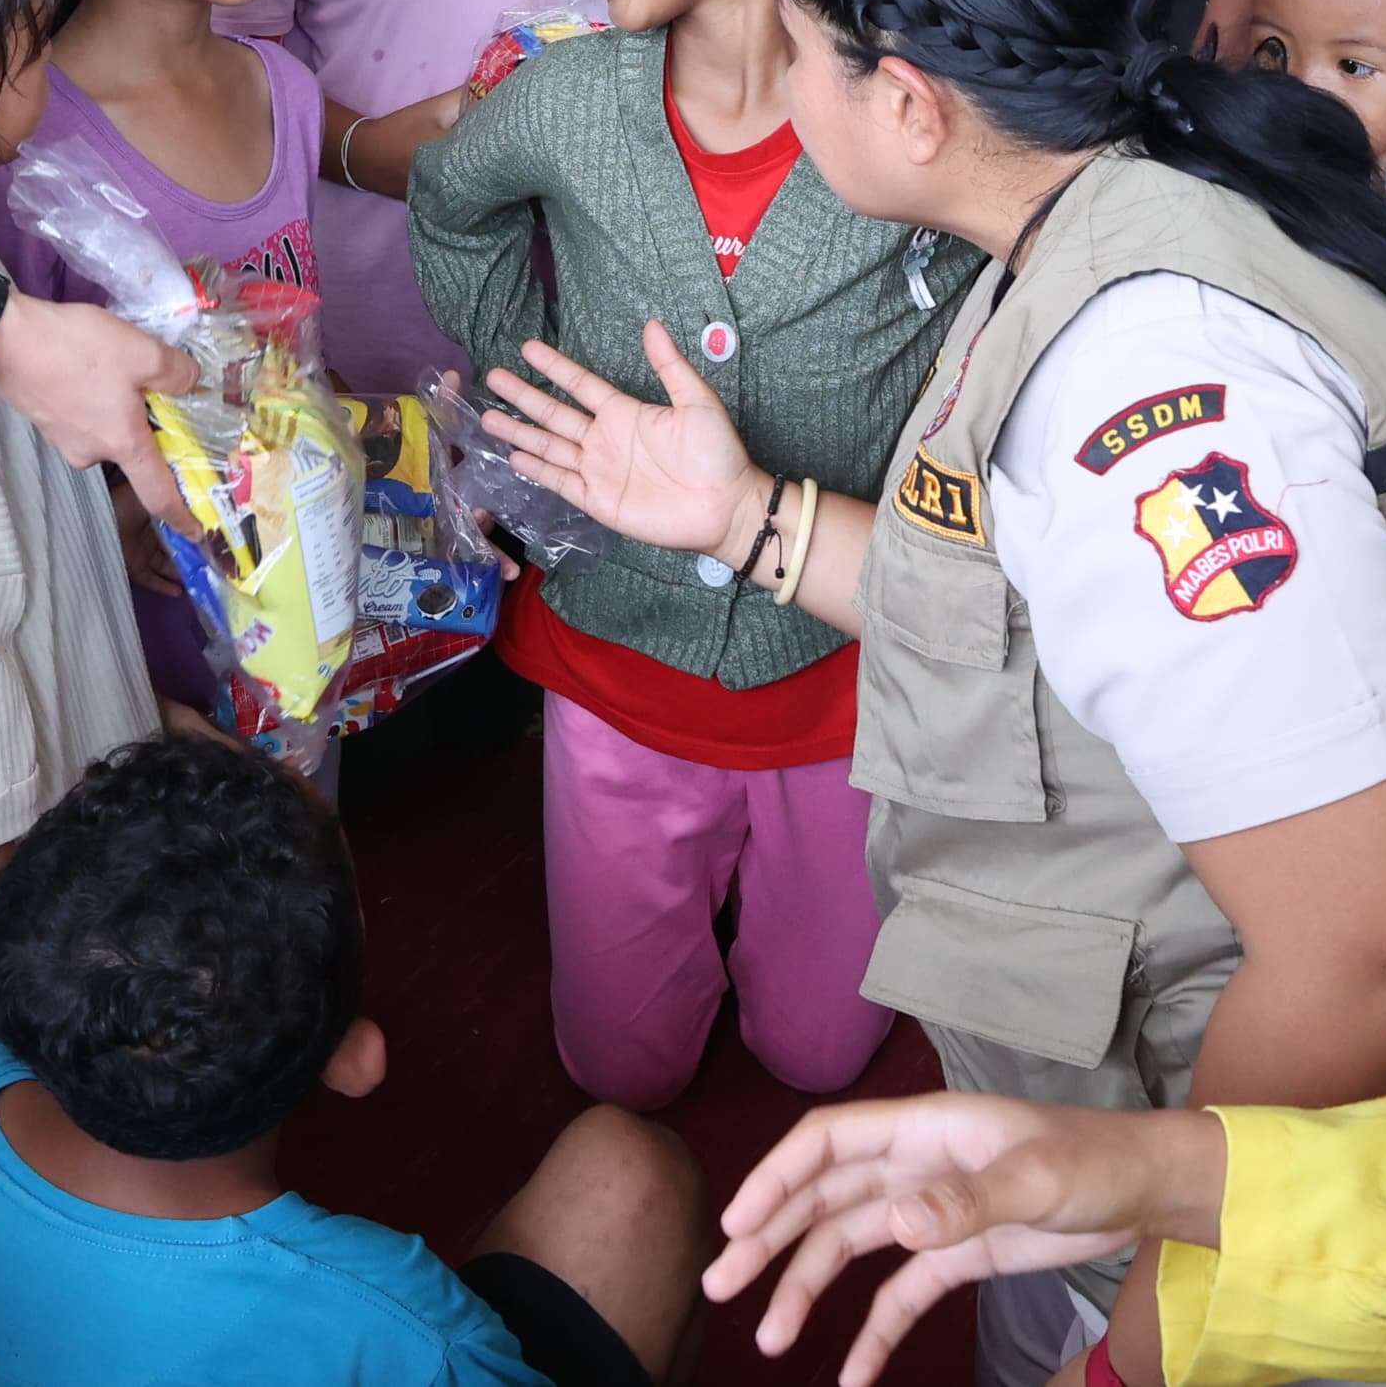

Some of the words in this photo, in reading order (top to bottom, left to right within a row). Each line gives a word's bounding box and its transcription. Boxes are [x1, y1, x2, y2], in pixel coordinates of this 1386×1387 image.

[1101, 394, 1203, 454] SSDM
[1174, 543, 1233, 604] MABES
[1228, 530, 1284, 559] POLRI
